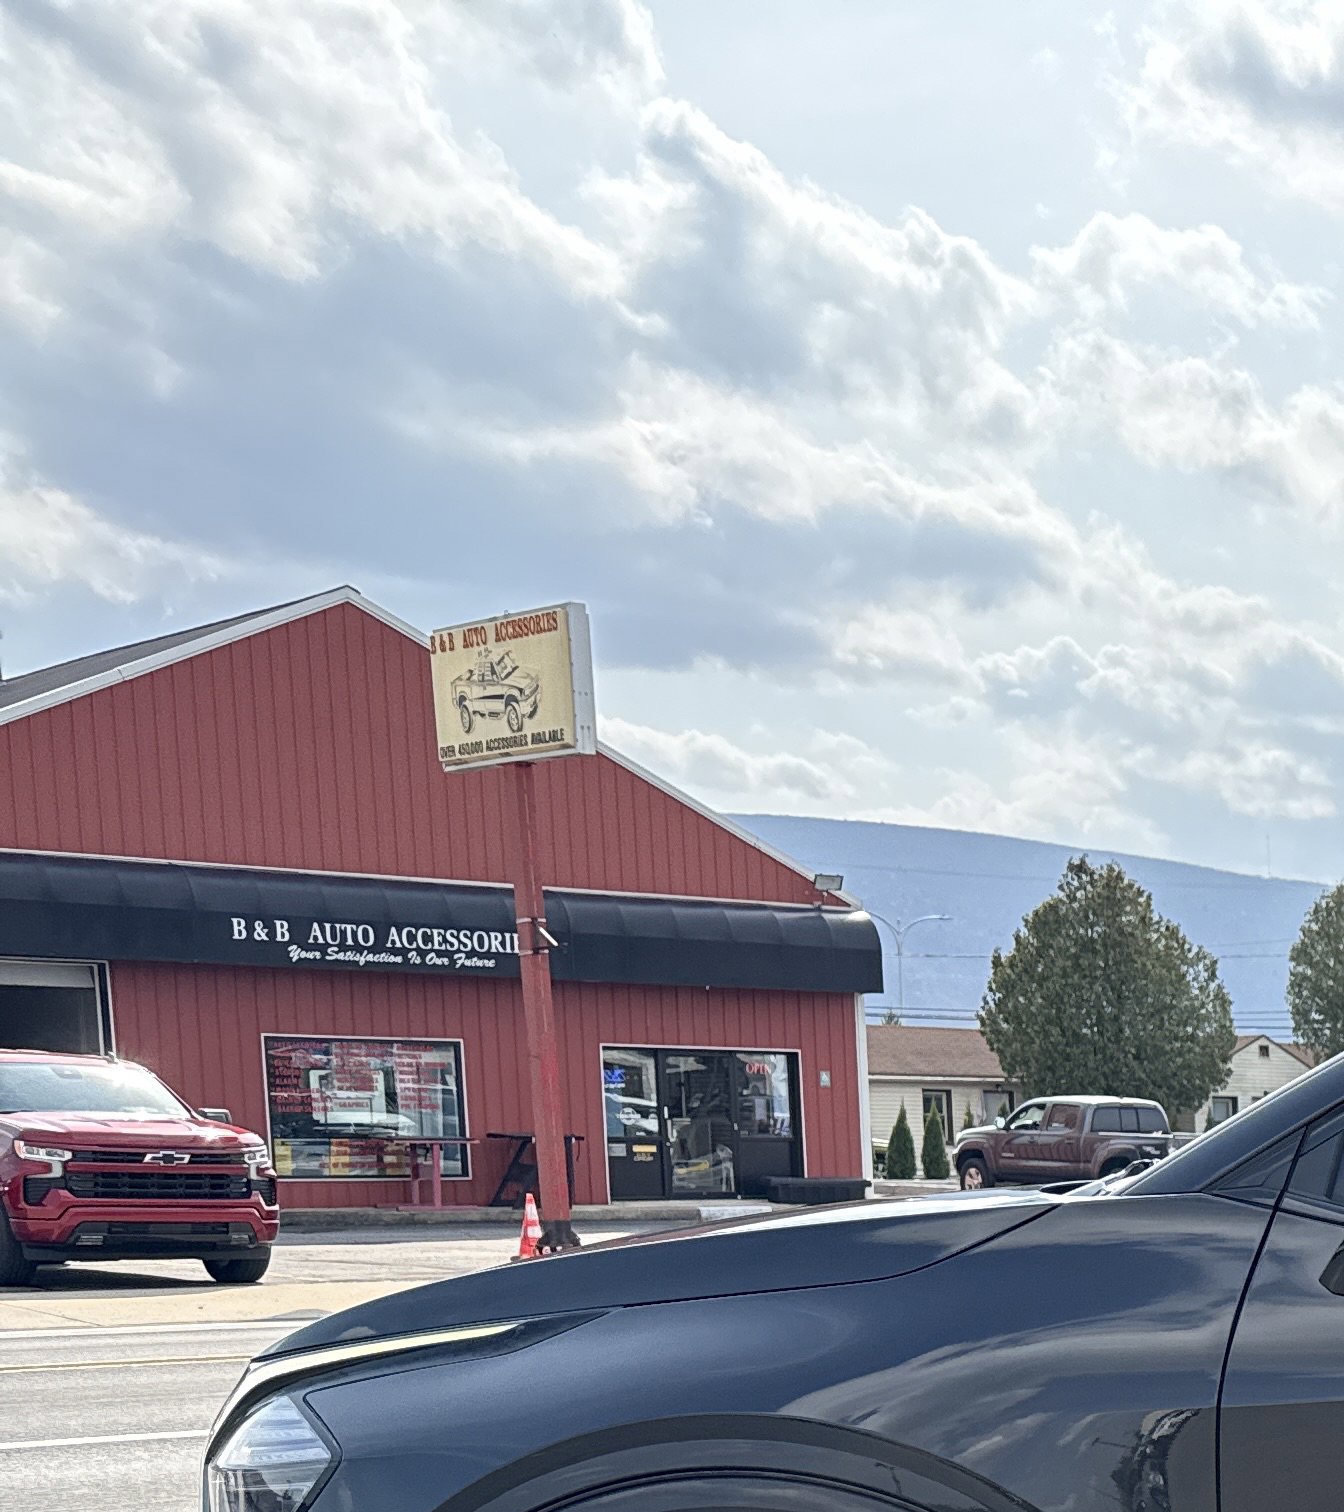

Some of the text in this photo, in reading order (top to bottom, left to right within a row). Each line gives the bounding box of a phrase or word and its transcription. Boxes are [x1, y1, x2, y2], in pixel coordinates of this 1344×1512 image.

[430, 610, 558, 654] B & B AUTO ACCESSORIES
[485, 734, 528, 752] ACCESSORIES
[231, 917, 247, 940] B
[253, 920, 269, 941] &
[274, 920, 290, 942] B
[308, 921, 375, 947] AUTO
[287, 944, 496, 969] Your Satisfaction Is Our Future
